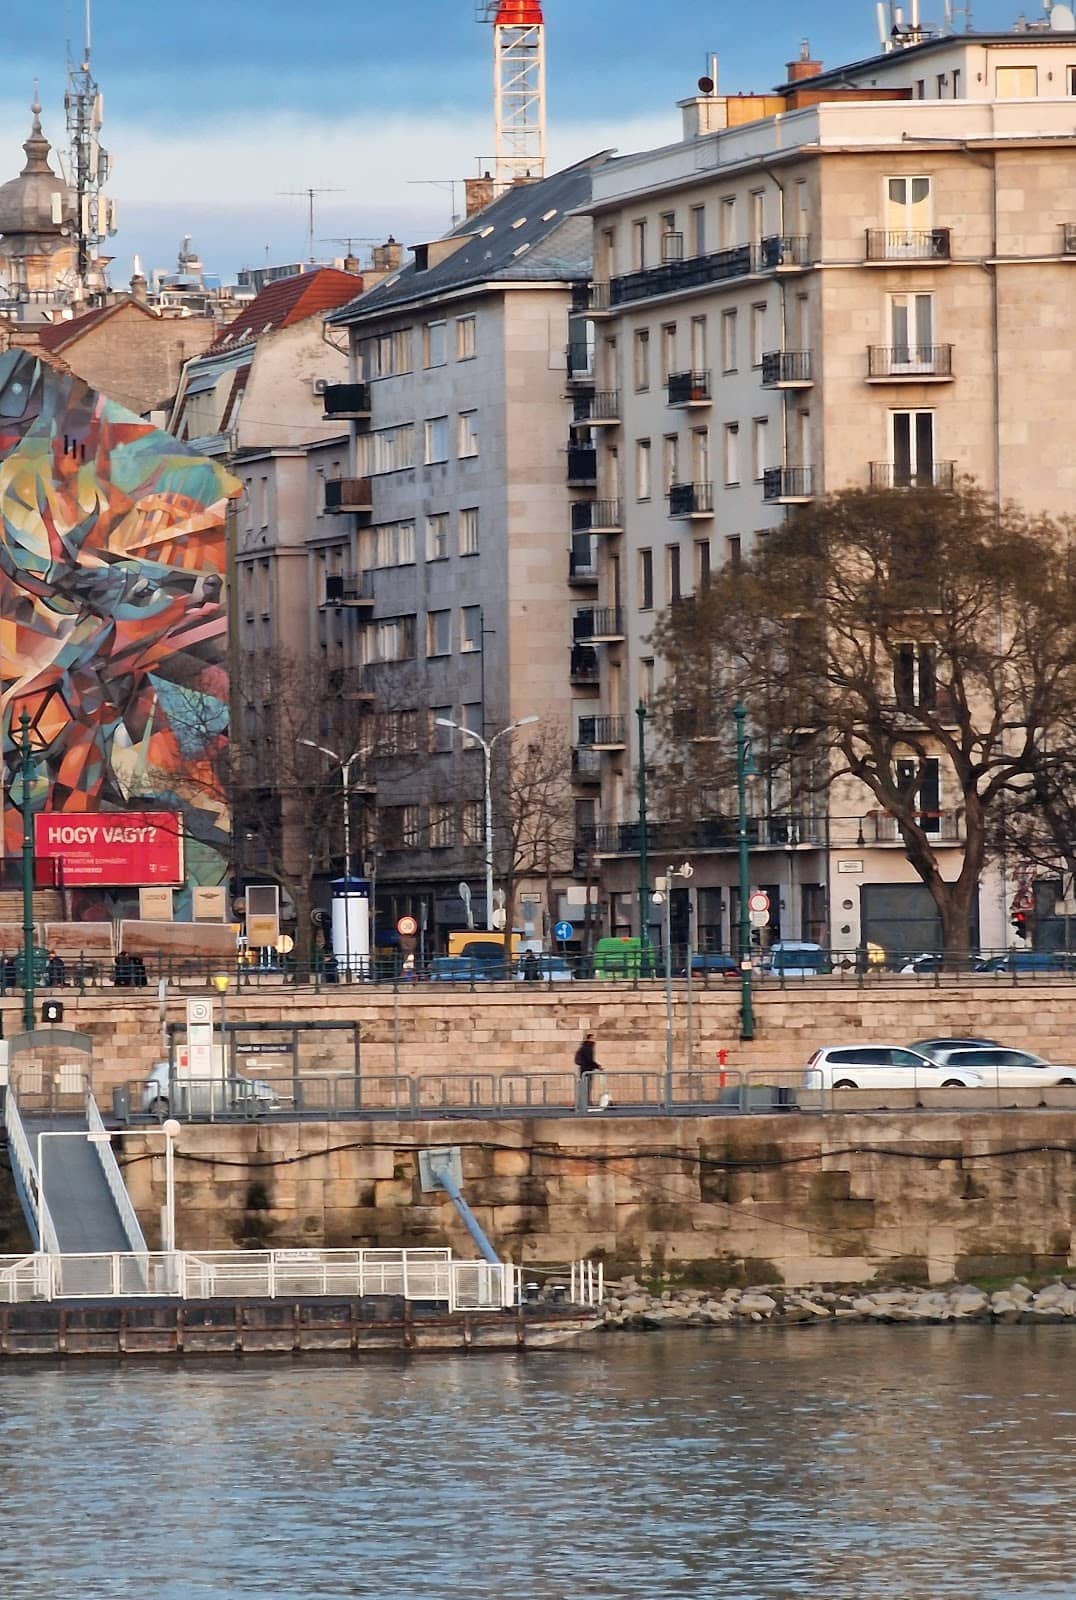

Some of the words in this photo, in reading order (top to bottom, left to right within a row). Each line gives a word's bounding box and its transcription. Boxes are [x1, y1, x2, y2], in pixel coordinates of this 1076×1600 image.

[48, 826, 98, 844] HOGY
[102, 826, 157, 843] VAGY?
[48, 1007, 57, 1019] 8
